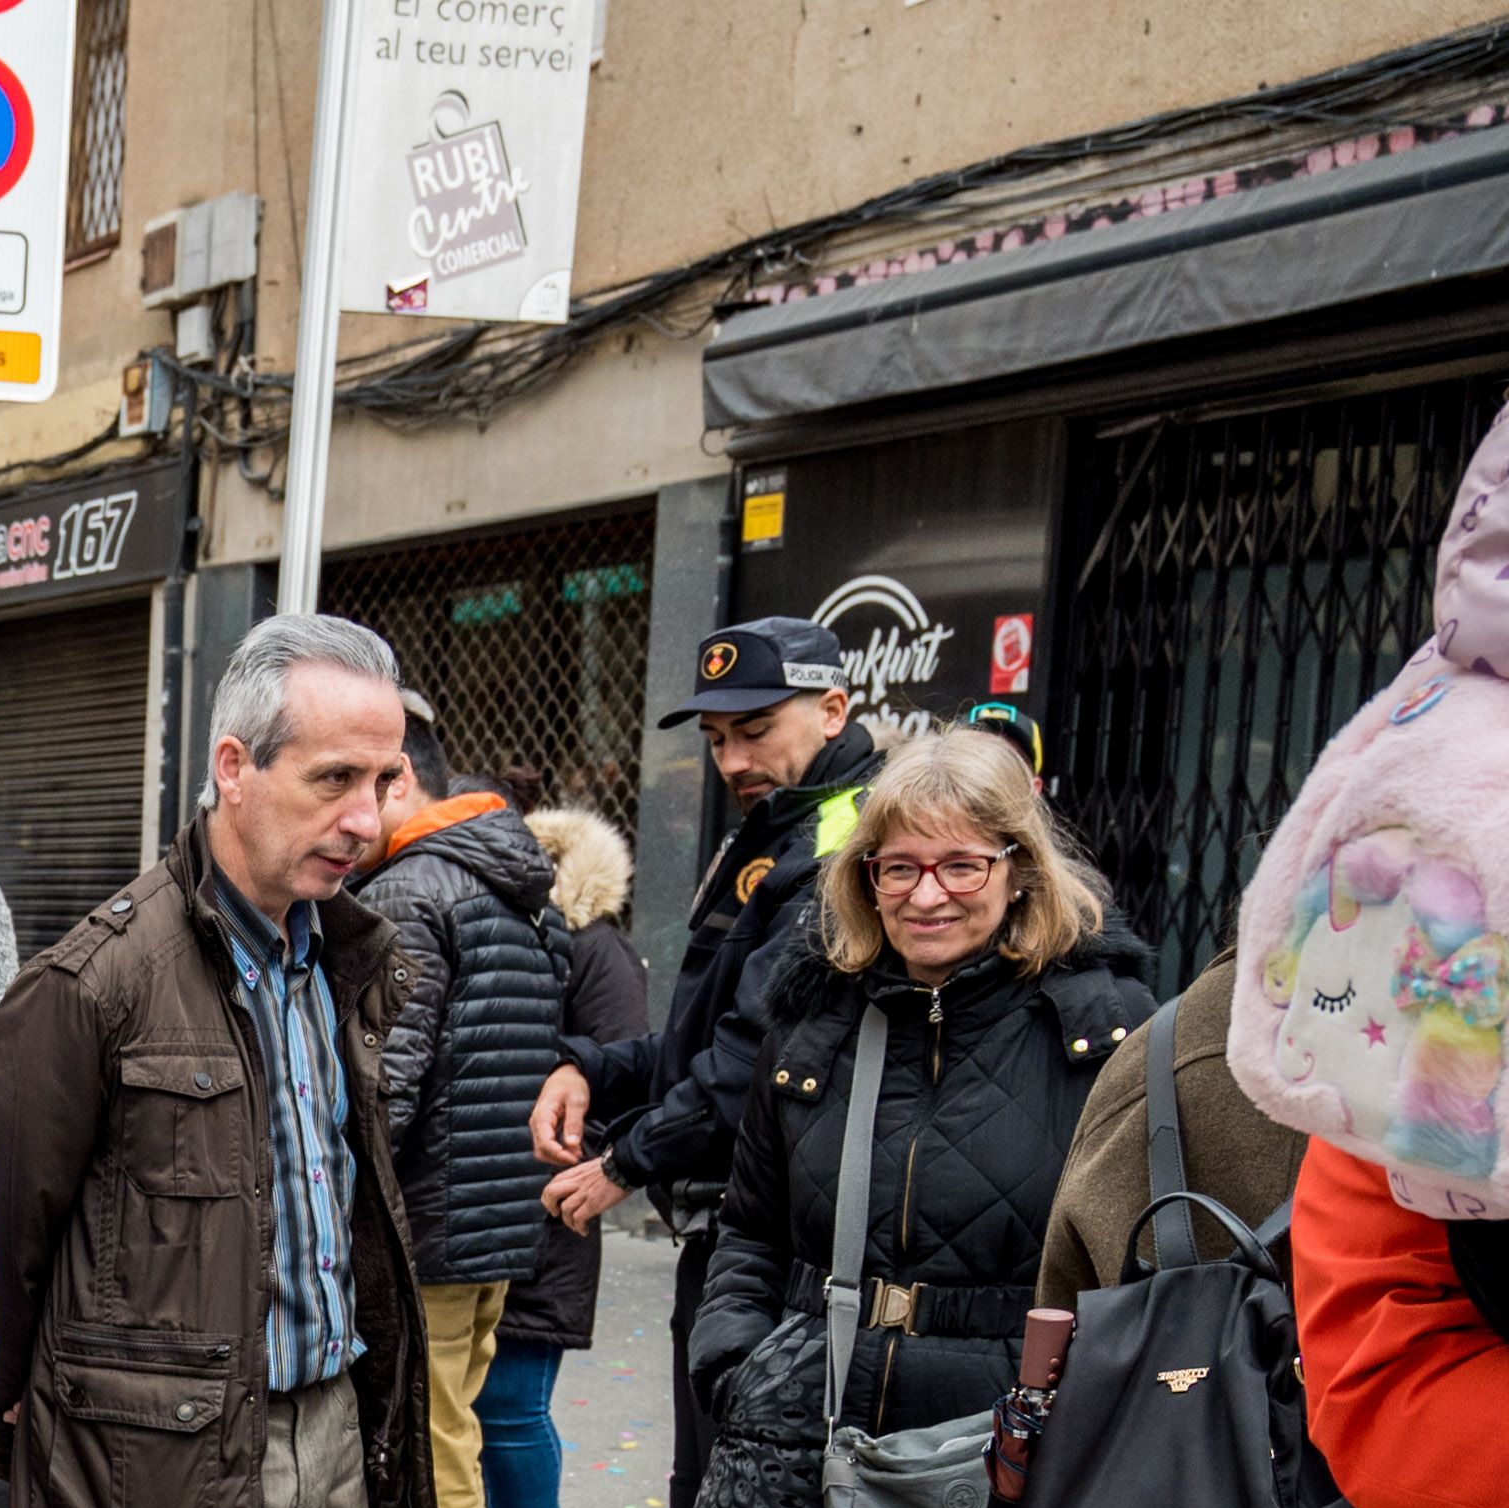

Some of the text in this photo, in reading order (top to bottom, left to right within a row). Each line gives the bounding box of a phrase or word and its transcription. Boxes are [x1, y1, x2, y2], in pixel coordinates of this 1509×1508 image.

[437, 0, 565, 36] comerç
[376, 28, 574, 72] al teu servei
[407, 165, 531, 259] Centre
[435, 229, 521, 277] COMERCIAL
[52, 490, 138, 580] 167
